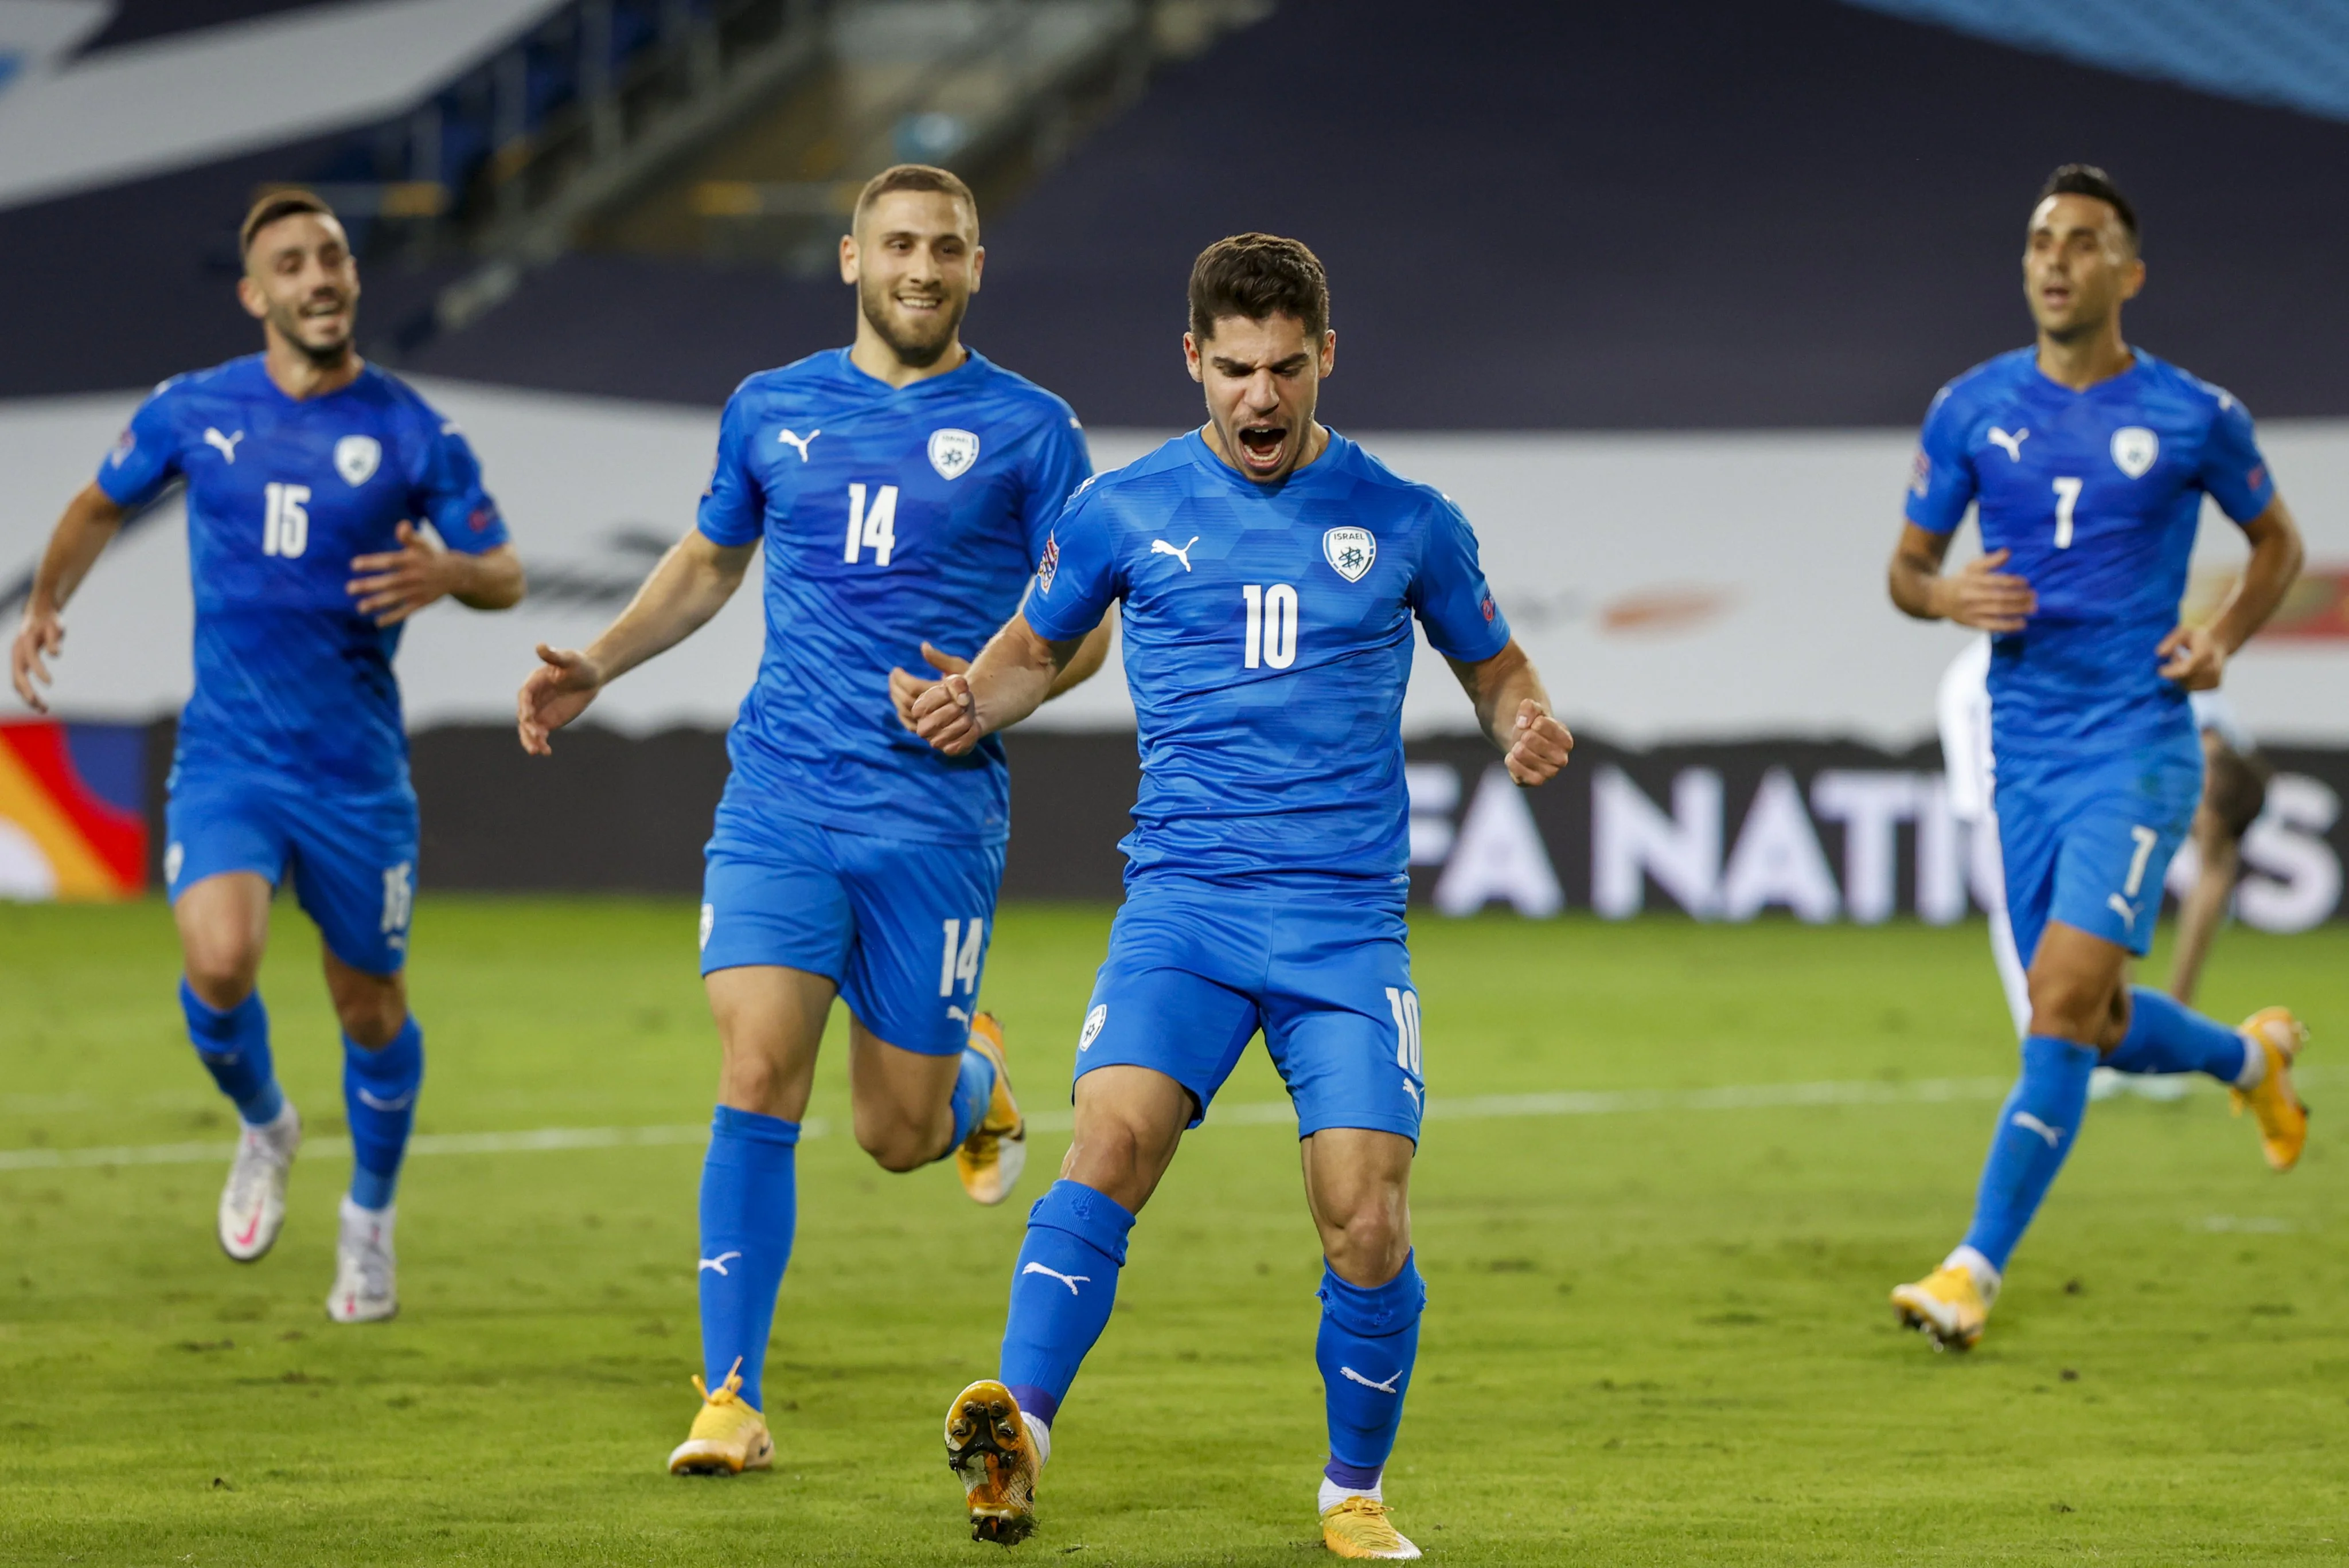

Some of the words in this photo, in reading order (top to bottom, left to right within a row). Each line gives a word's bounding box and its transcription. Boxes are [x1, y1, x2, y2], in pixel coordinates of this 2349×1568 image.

[263, 482, 311, 558] 15
[844, 483, 899, 566] 14
[2052, 476, 2083, 549] 7
[1243, 583, 1298, 670] 10
[1590, 765, 2344, 933] NATIS
[2124, 824, 2157, 897] 7
[939, 918, 983, 996] 14
[1385, 987, 1421, 1076] 10
